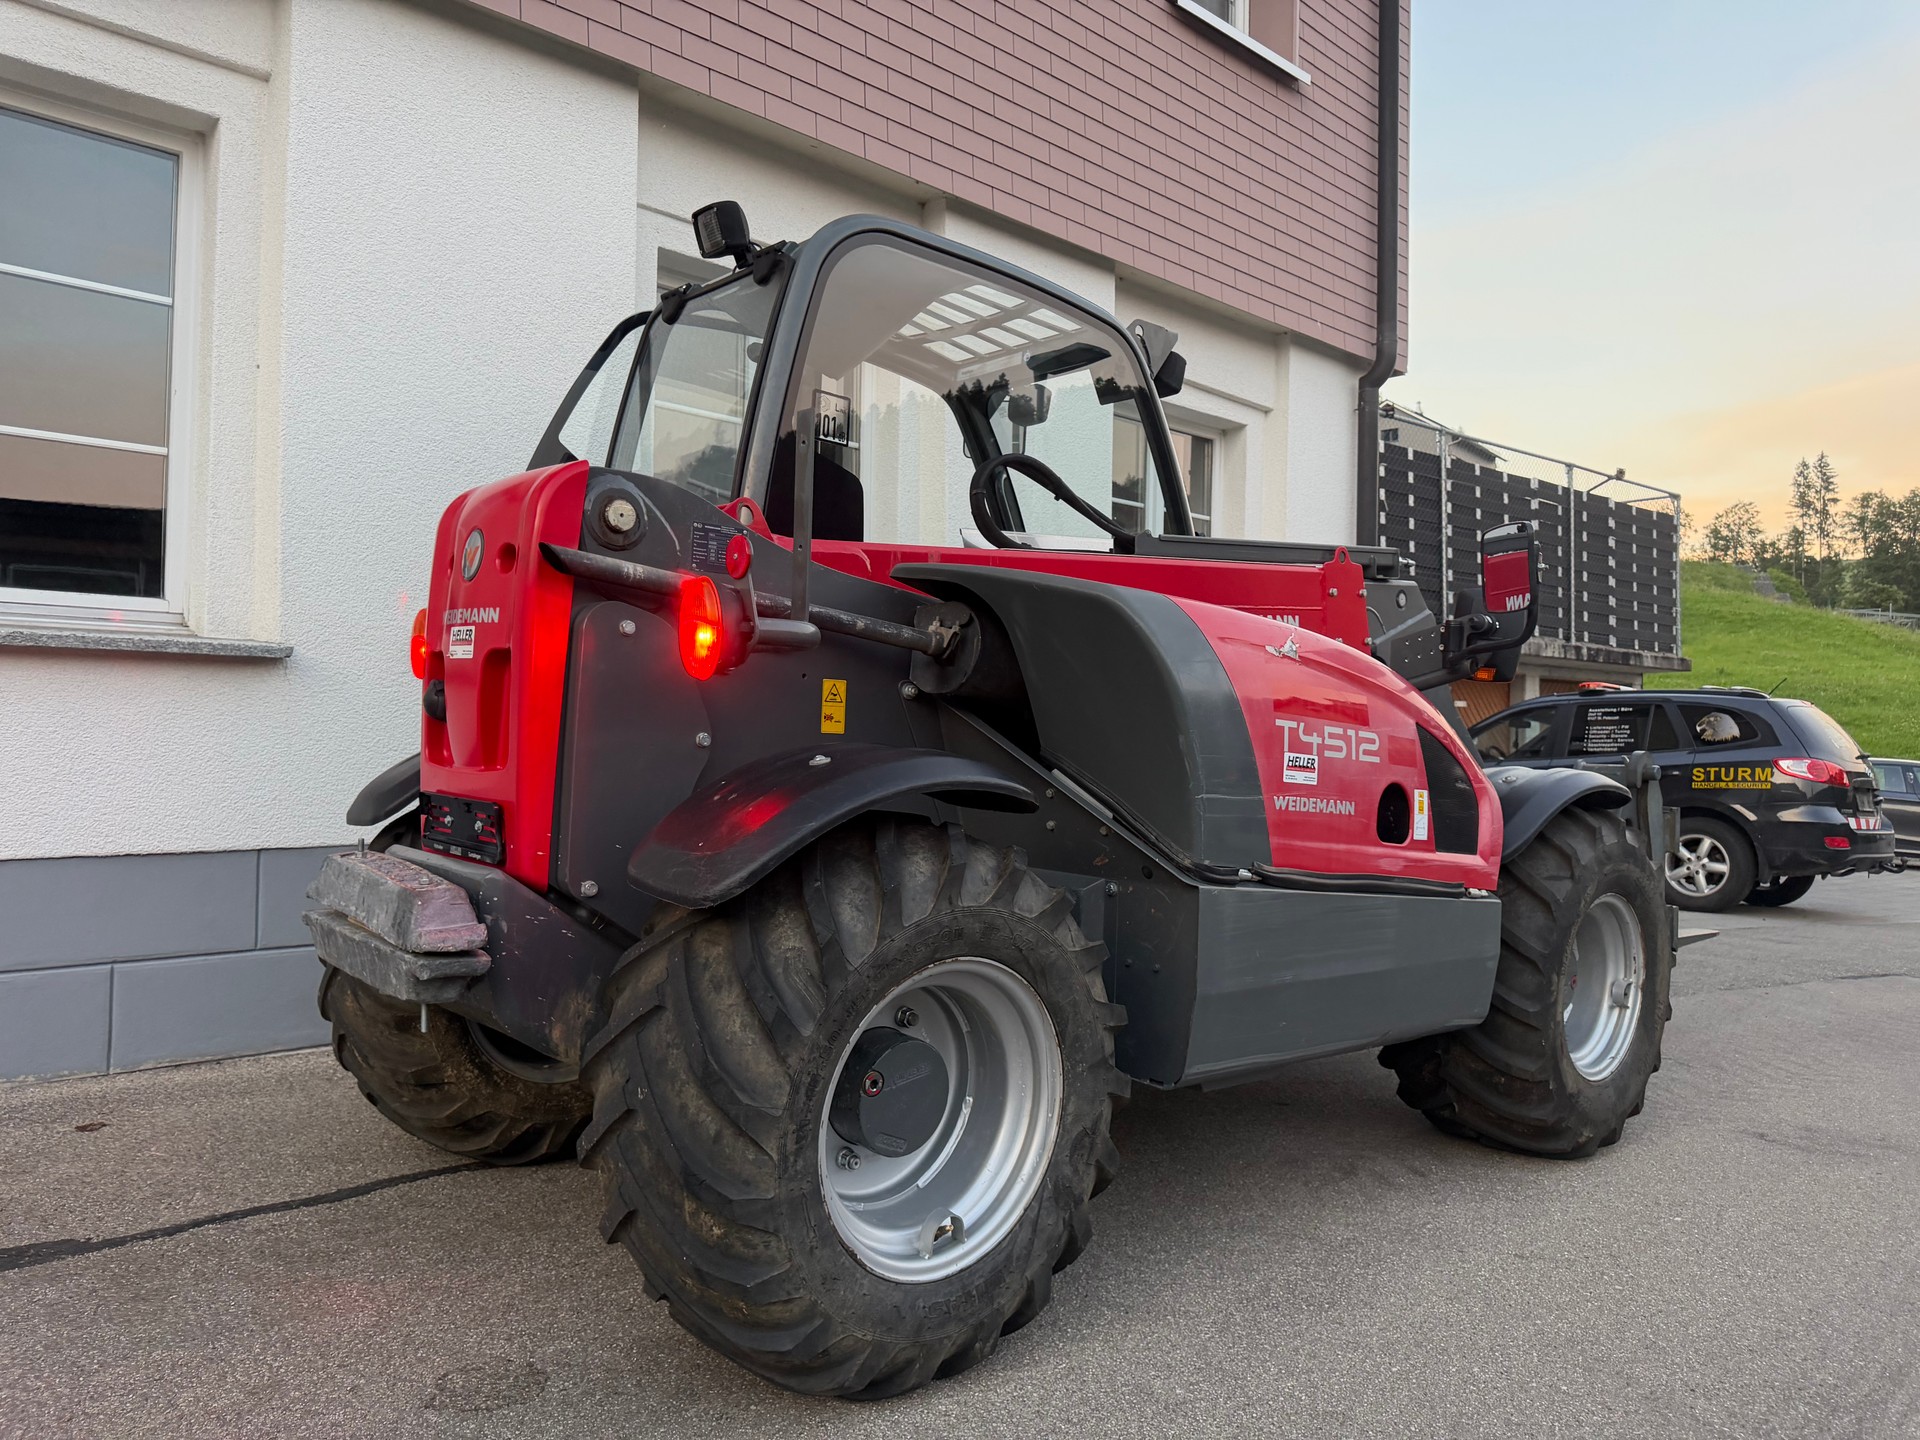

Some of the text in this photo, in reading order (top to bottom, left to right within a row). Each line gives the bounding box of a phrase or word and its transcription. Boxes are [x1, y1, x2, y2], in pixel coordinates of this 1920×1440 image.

[444, 607, 500, 625] EIDEMANN
[452, 629, 473, 641] HELLER
[1275, 719, 1380, 763] T4512
[1287, 755, 1316, 769] HELLER
[1692, 767, 1772, 781] STURM
[1273, 796, 1355, 815] WEIDEMANN
